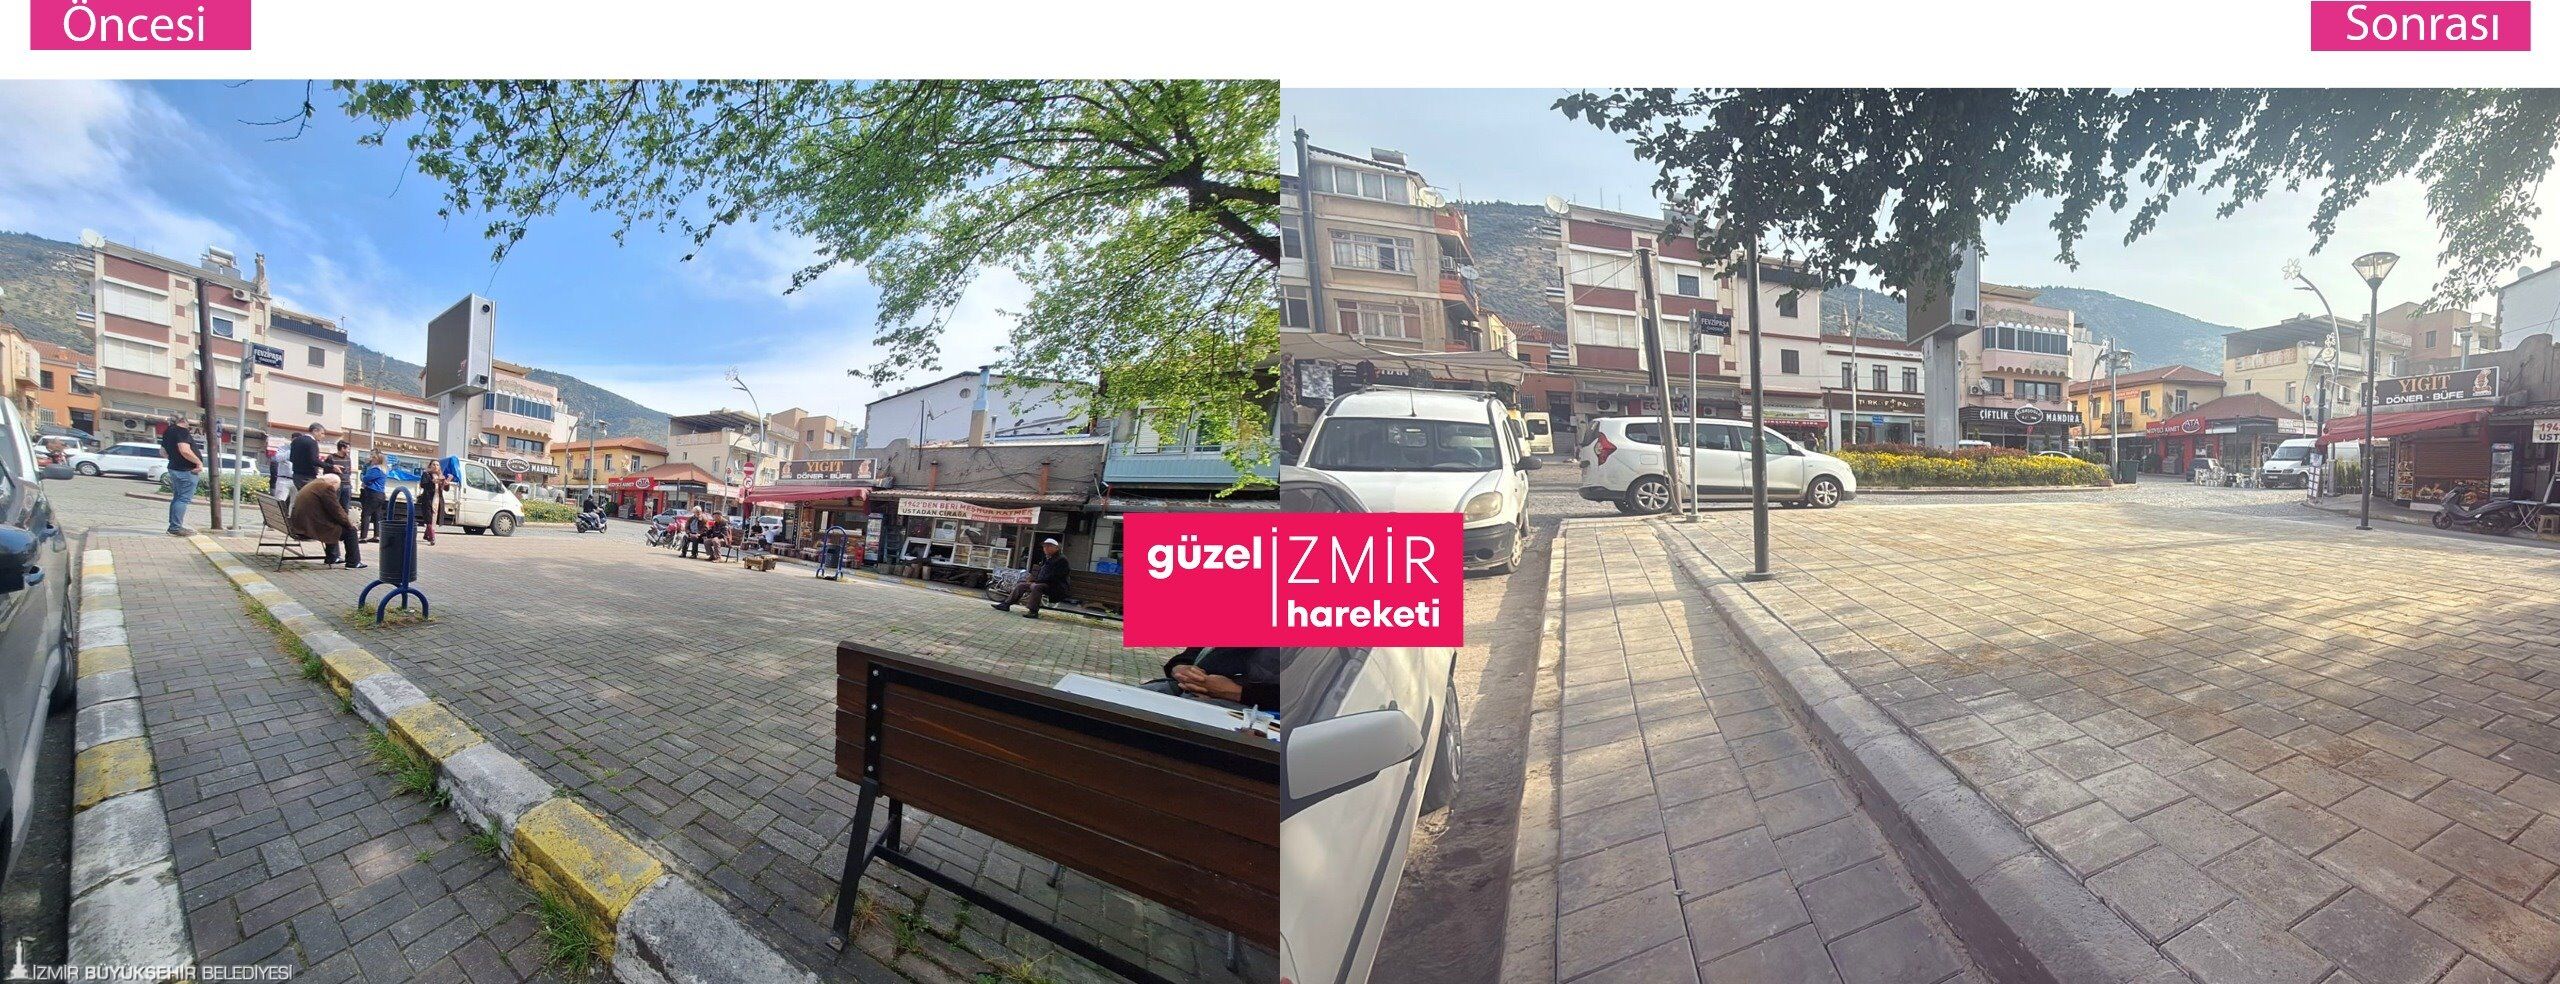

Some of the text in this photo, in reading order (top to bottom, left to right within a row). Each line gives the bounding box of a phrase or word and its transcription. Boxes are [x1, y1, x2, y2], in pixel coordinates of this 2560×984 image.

[2386, 394, 2423, 404] DÖNER
[2433, 390, 2464, 400] BÜFE
[1980, 409, 2079, 423] ÇİFTLİK MANDIRA
[830, 471, 852, 479] BÜFE
[902, 508, 937, 516] USTADAN
